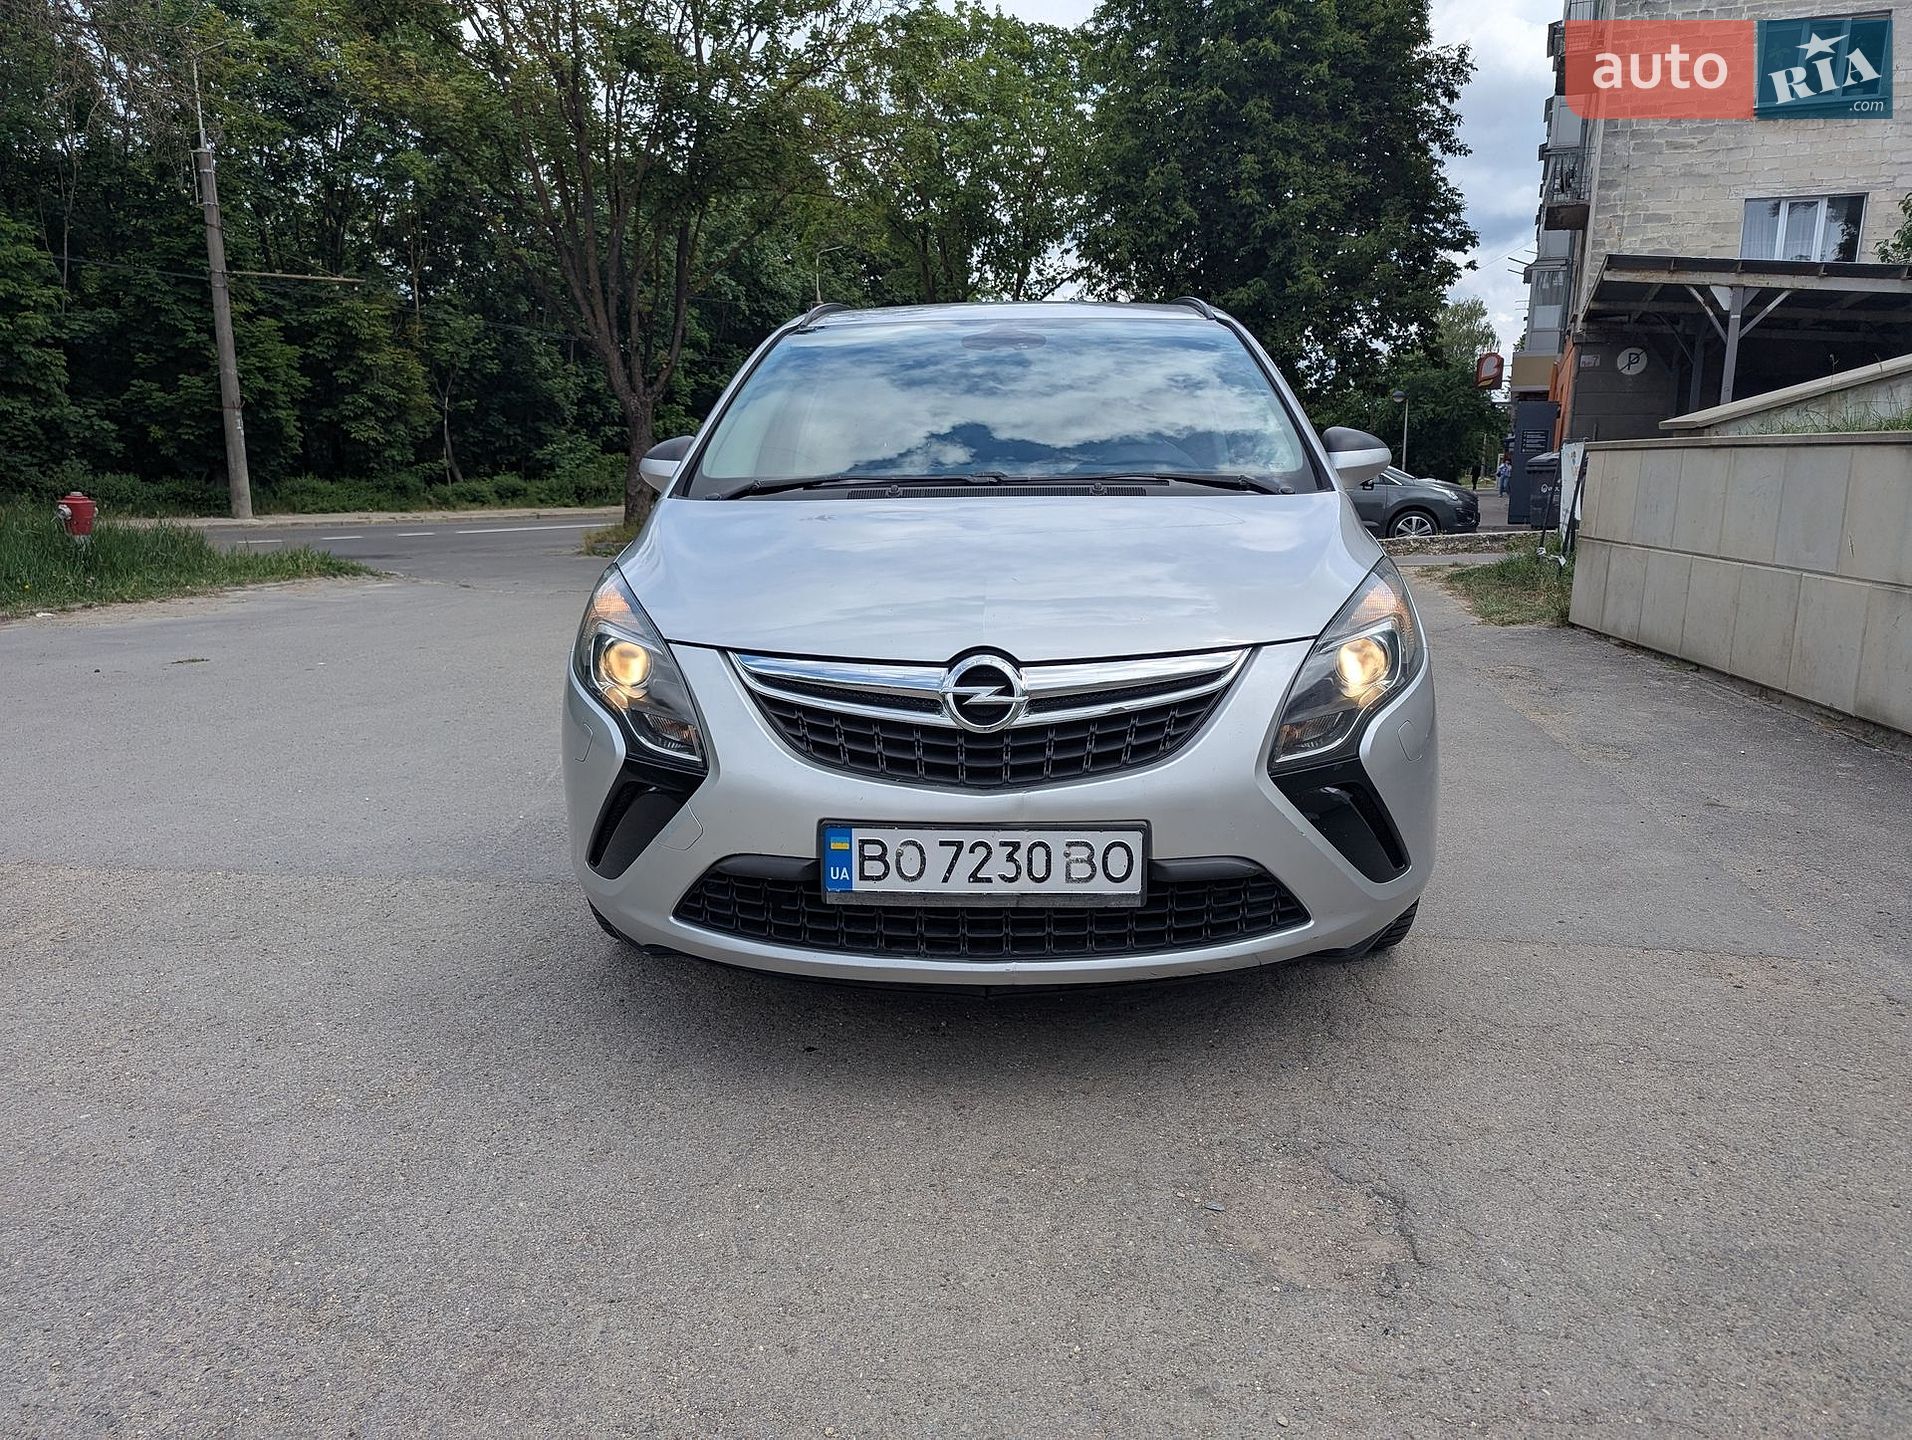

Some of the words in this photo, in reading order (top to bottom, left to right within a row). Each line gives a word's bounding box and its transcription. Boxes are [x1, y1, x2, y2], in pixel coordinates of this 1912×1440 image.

[830, 867, 850, 881] UA
[858, 838, 926, 882] BO
[938, 839, 1052, 883] 7230
[1064, 839, 1135, 884] BO
